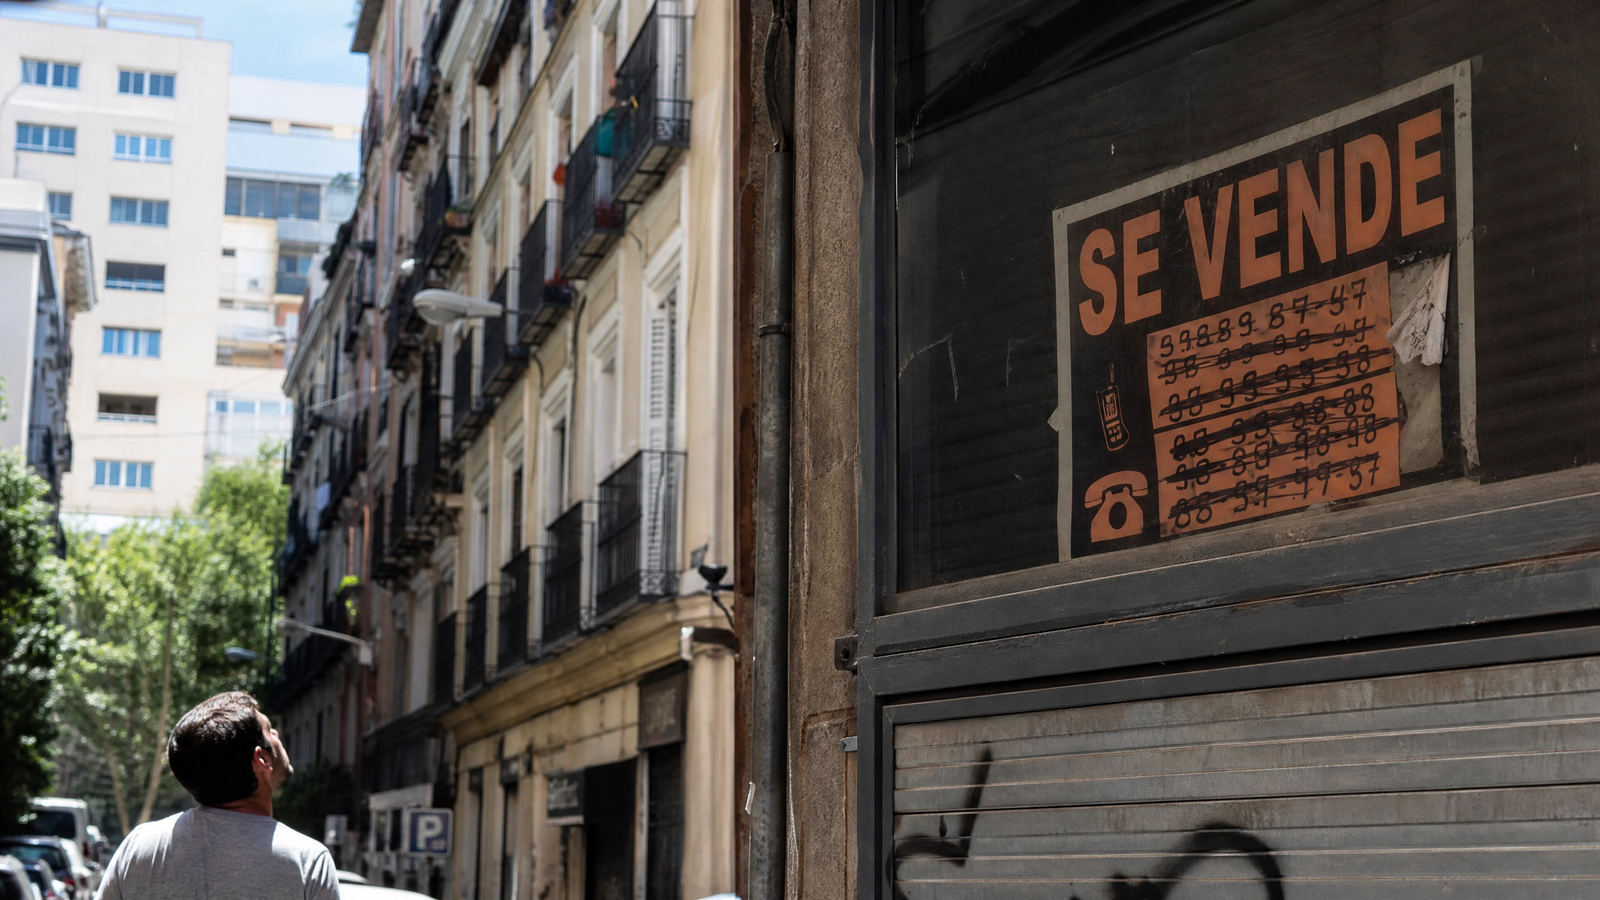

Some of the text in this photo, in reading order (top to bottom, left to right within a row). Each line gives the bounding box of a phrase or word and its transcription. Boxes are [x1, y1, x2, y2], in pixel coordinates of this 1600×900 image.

[1079, 108, 1445, 336] SE VENDE
[416, 815, 443, 850] P
